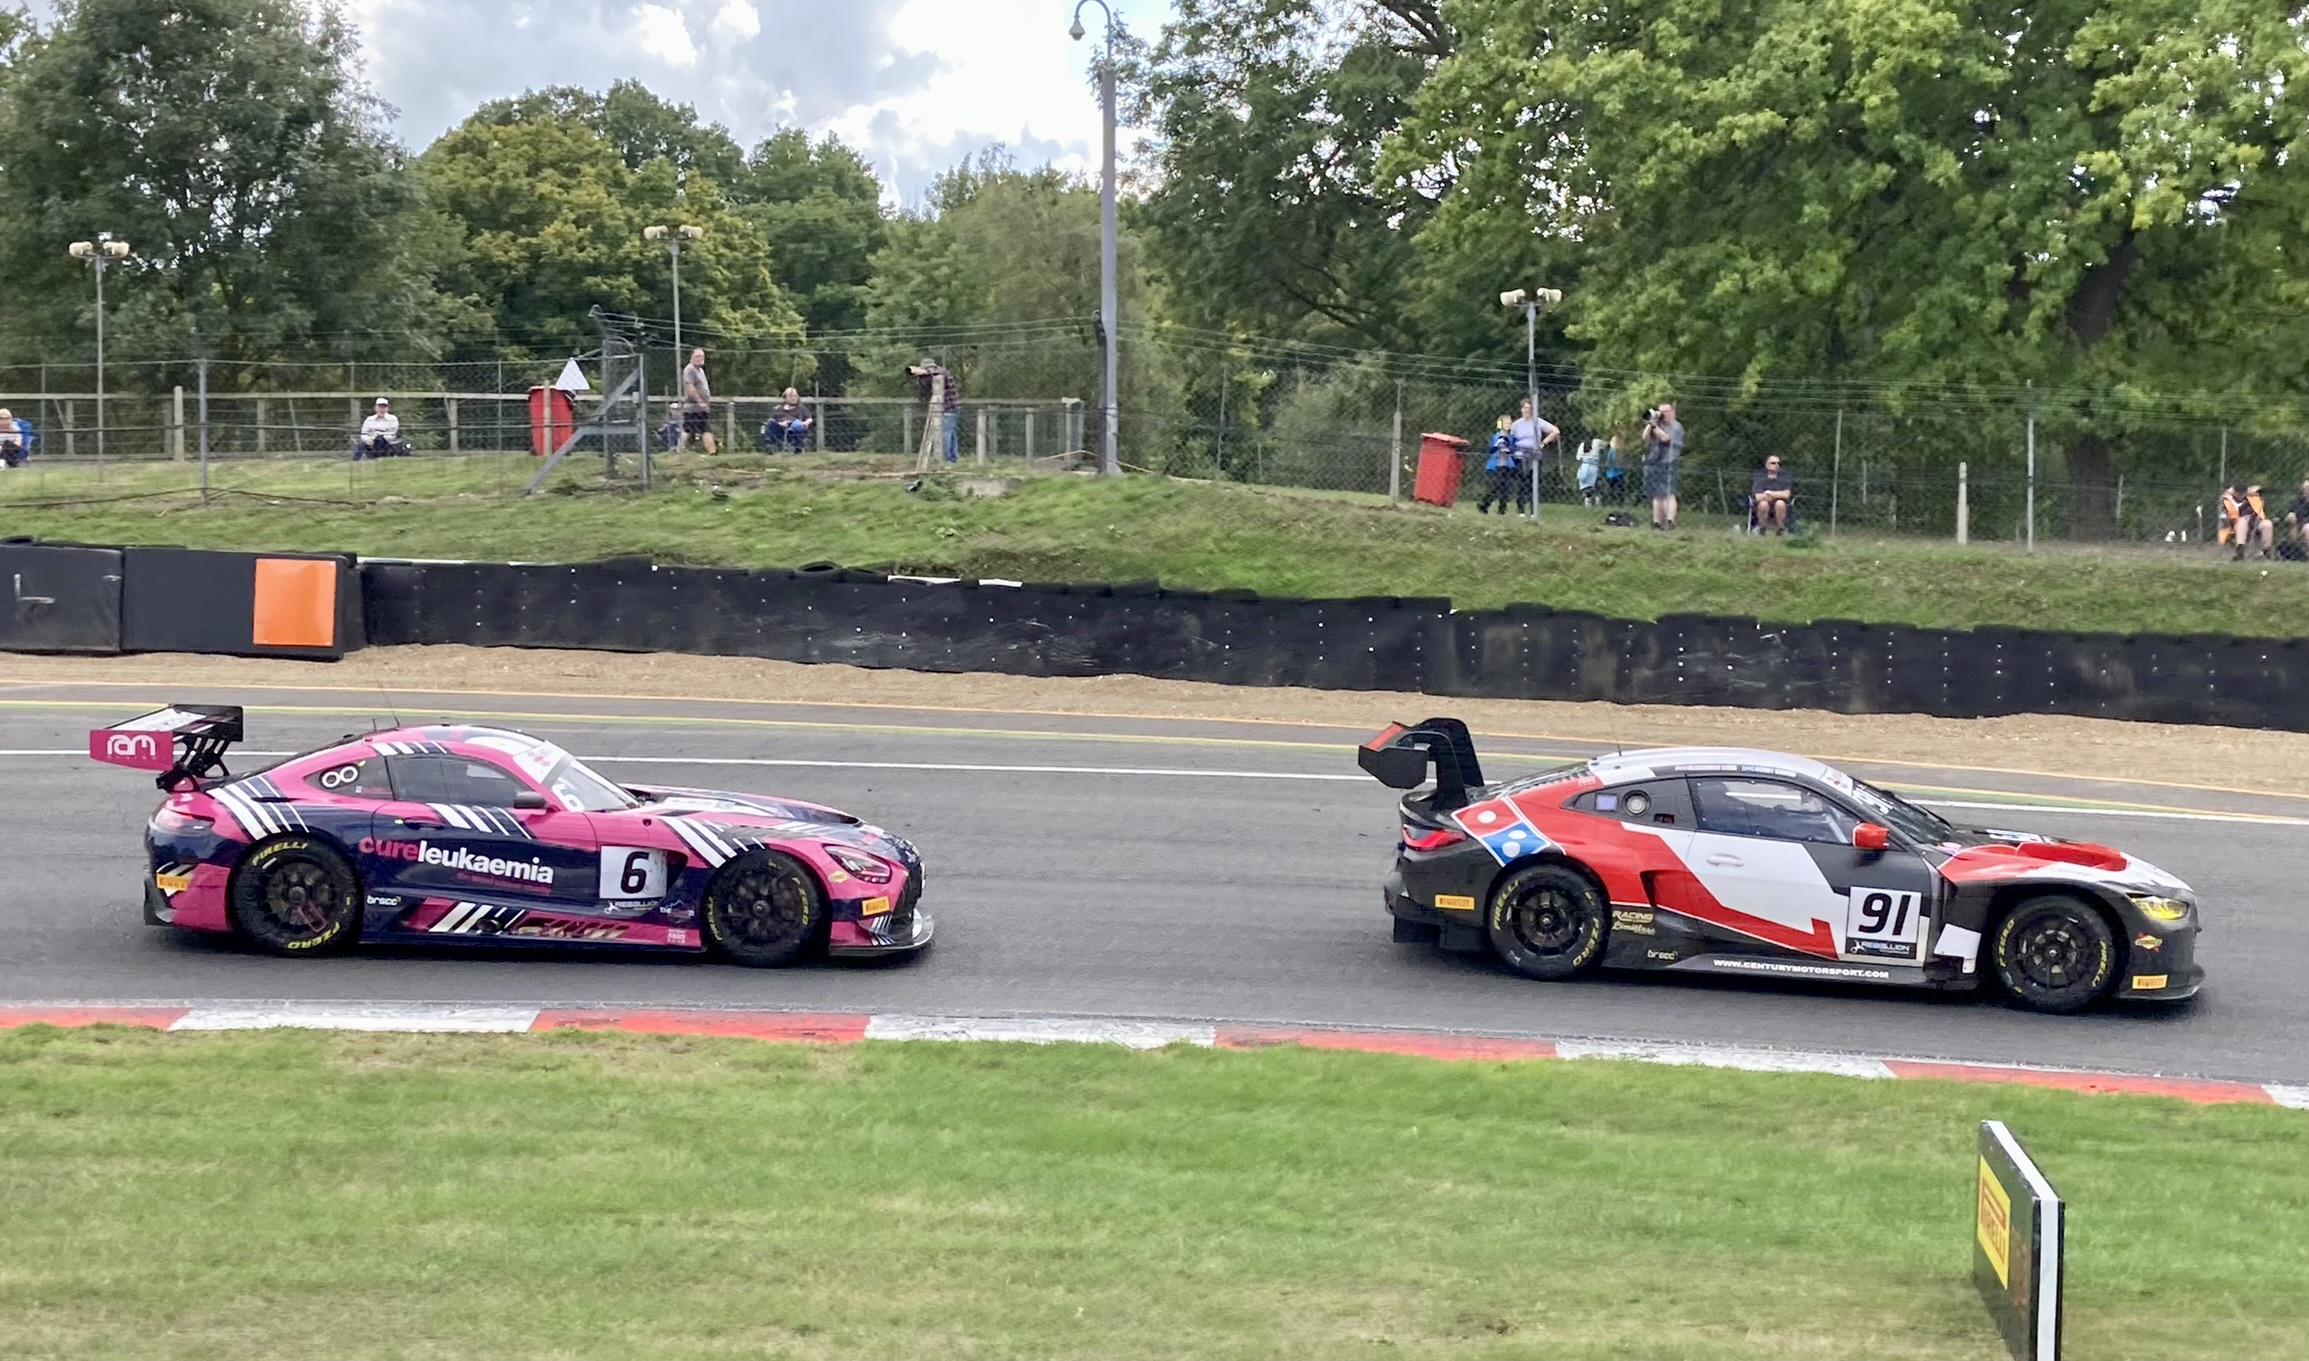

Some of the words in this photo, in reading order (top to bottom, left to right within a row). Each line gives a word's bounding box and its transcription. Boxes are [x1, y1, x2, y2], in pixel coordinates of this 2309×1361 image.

[251, 841, 309, 867] PIRELLI
[358, 836, 555, 884] cureleukaemia
[620, 851, 650, 894] 6
[1612, 910, 1654, 924] RACING
[1858, 892, 1912, 936] 91
[1861, 941, 1910, 952] REBELLION
[1713, 959, 1890, 979] WWW.CENTURYMOTORSPORT.COM
